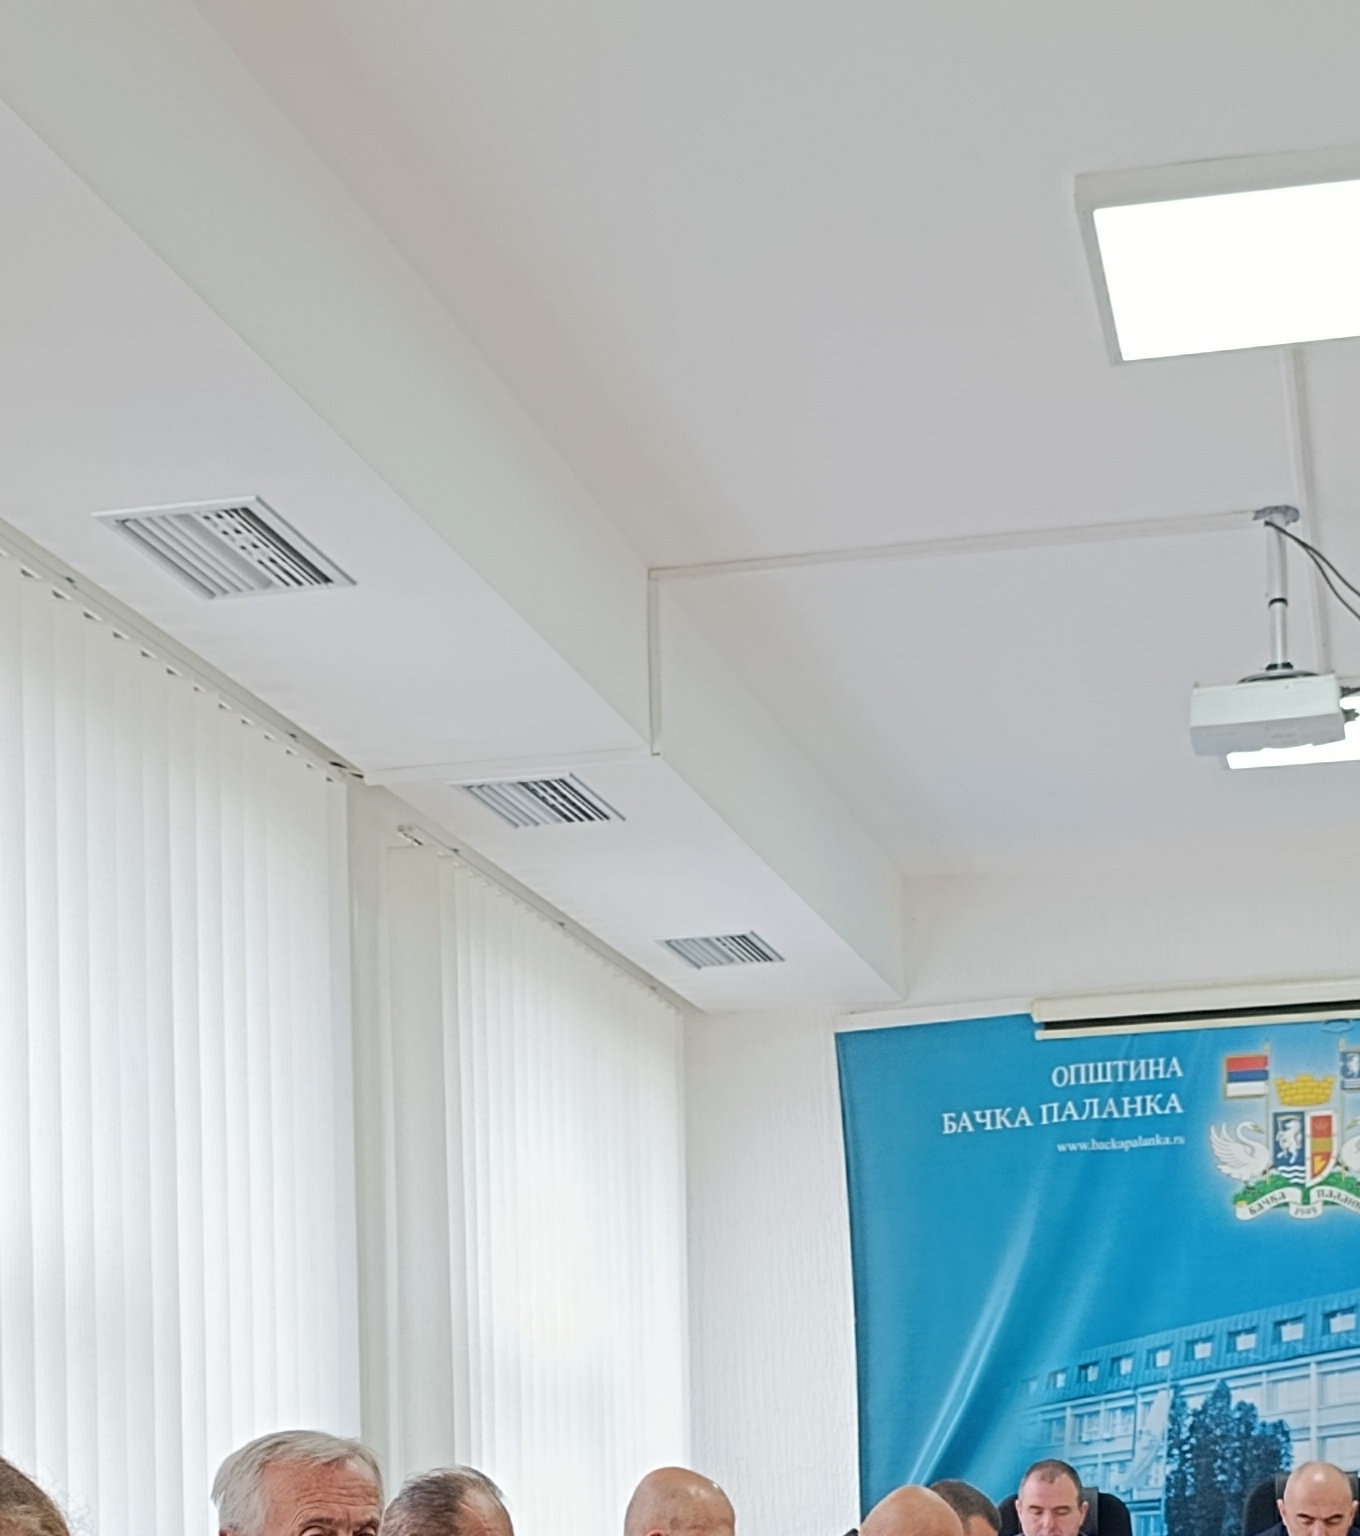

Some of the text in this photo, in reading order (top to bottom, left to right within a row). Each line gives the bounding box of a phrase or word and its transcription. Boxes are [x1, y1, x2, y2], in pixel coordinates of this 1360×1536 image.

[1050, 1056, 1184, 1088] ОПШТИНА
[941, 1092, 1184, 1135] БАЧКА ПАЛАНКА
[1056, 1133, 1186, 1153] www.backapalanka.rs
